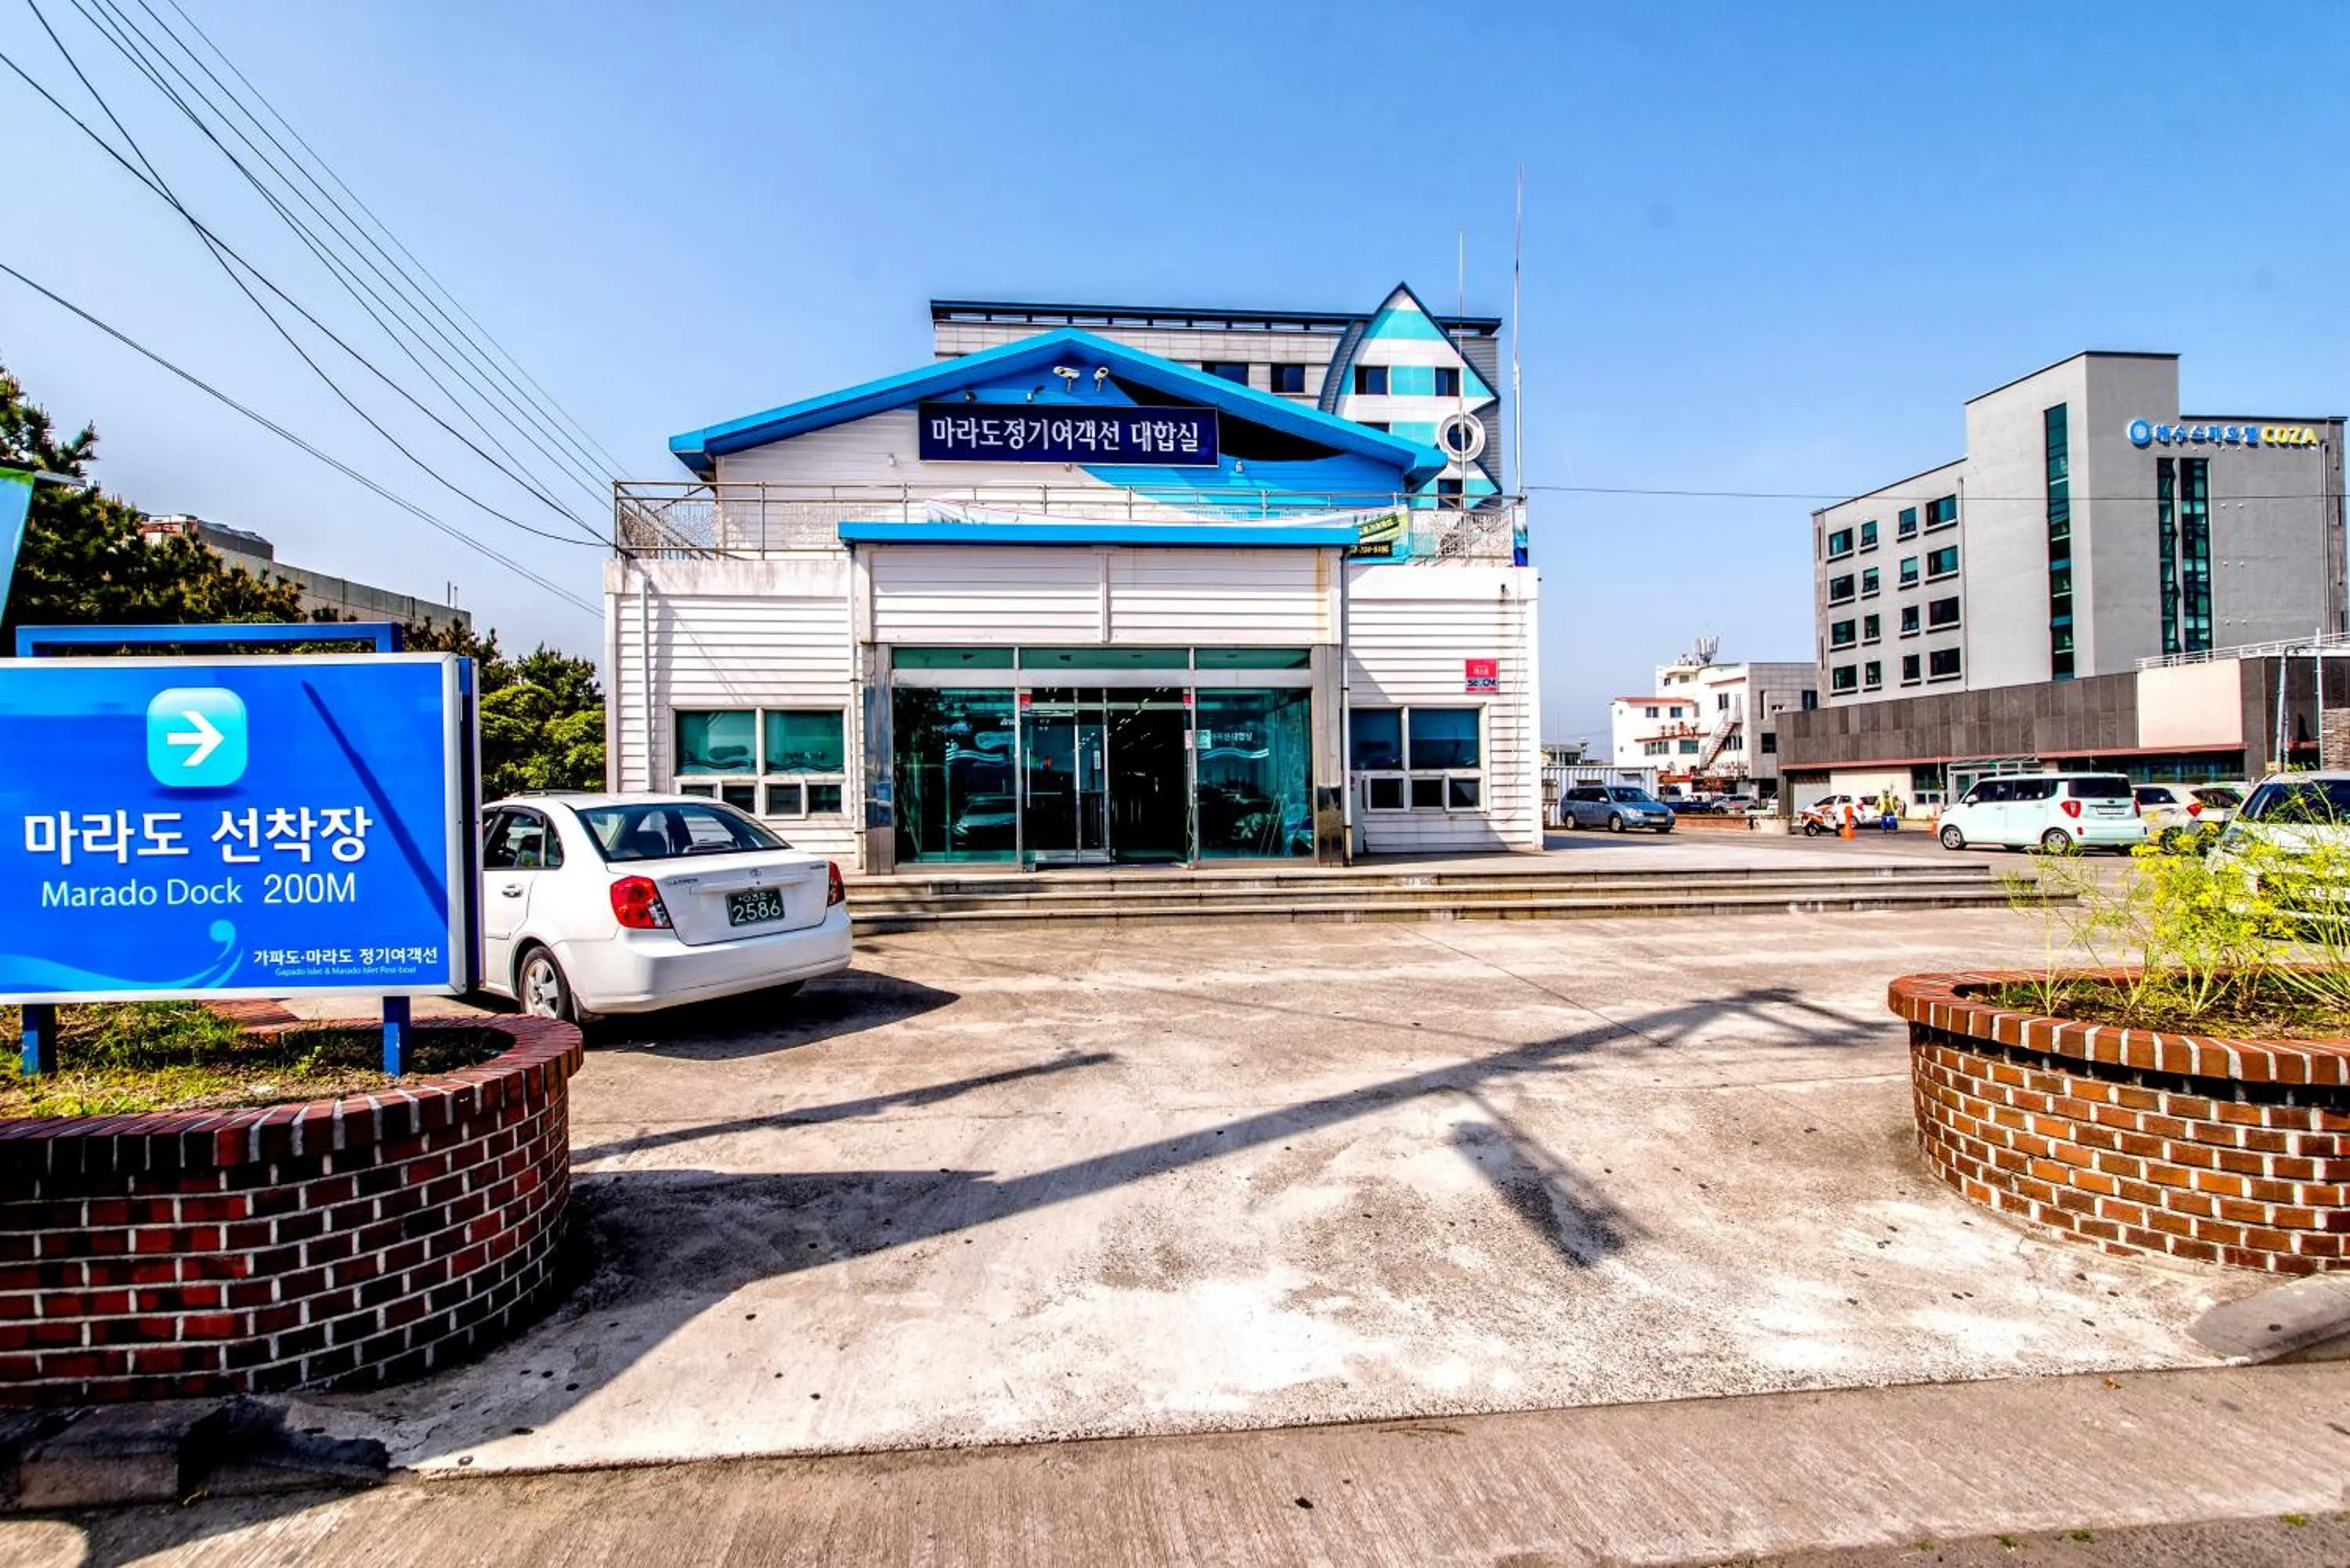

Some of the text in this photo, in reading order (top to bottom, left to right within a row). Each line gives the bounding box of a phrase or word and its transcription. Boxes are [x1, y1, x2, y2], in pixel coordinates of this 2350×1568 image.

[932, 417, 1198, 452] 마라도정기여객선 대합실
[2261, 426, 2319, 444] COZA
[24, 806, 373, 865] 마라도 선착장
[42, 873, 356, 908] Marado Dock 200M
[732, 899, 782, 923] 2586
[360, 947, 438, 965] 정기여객선
[331, 966, 361, 975] Marado
